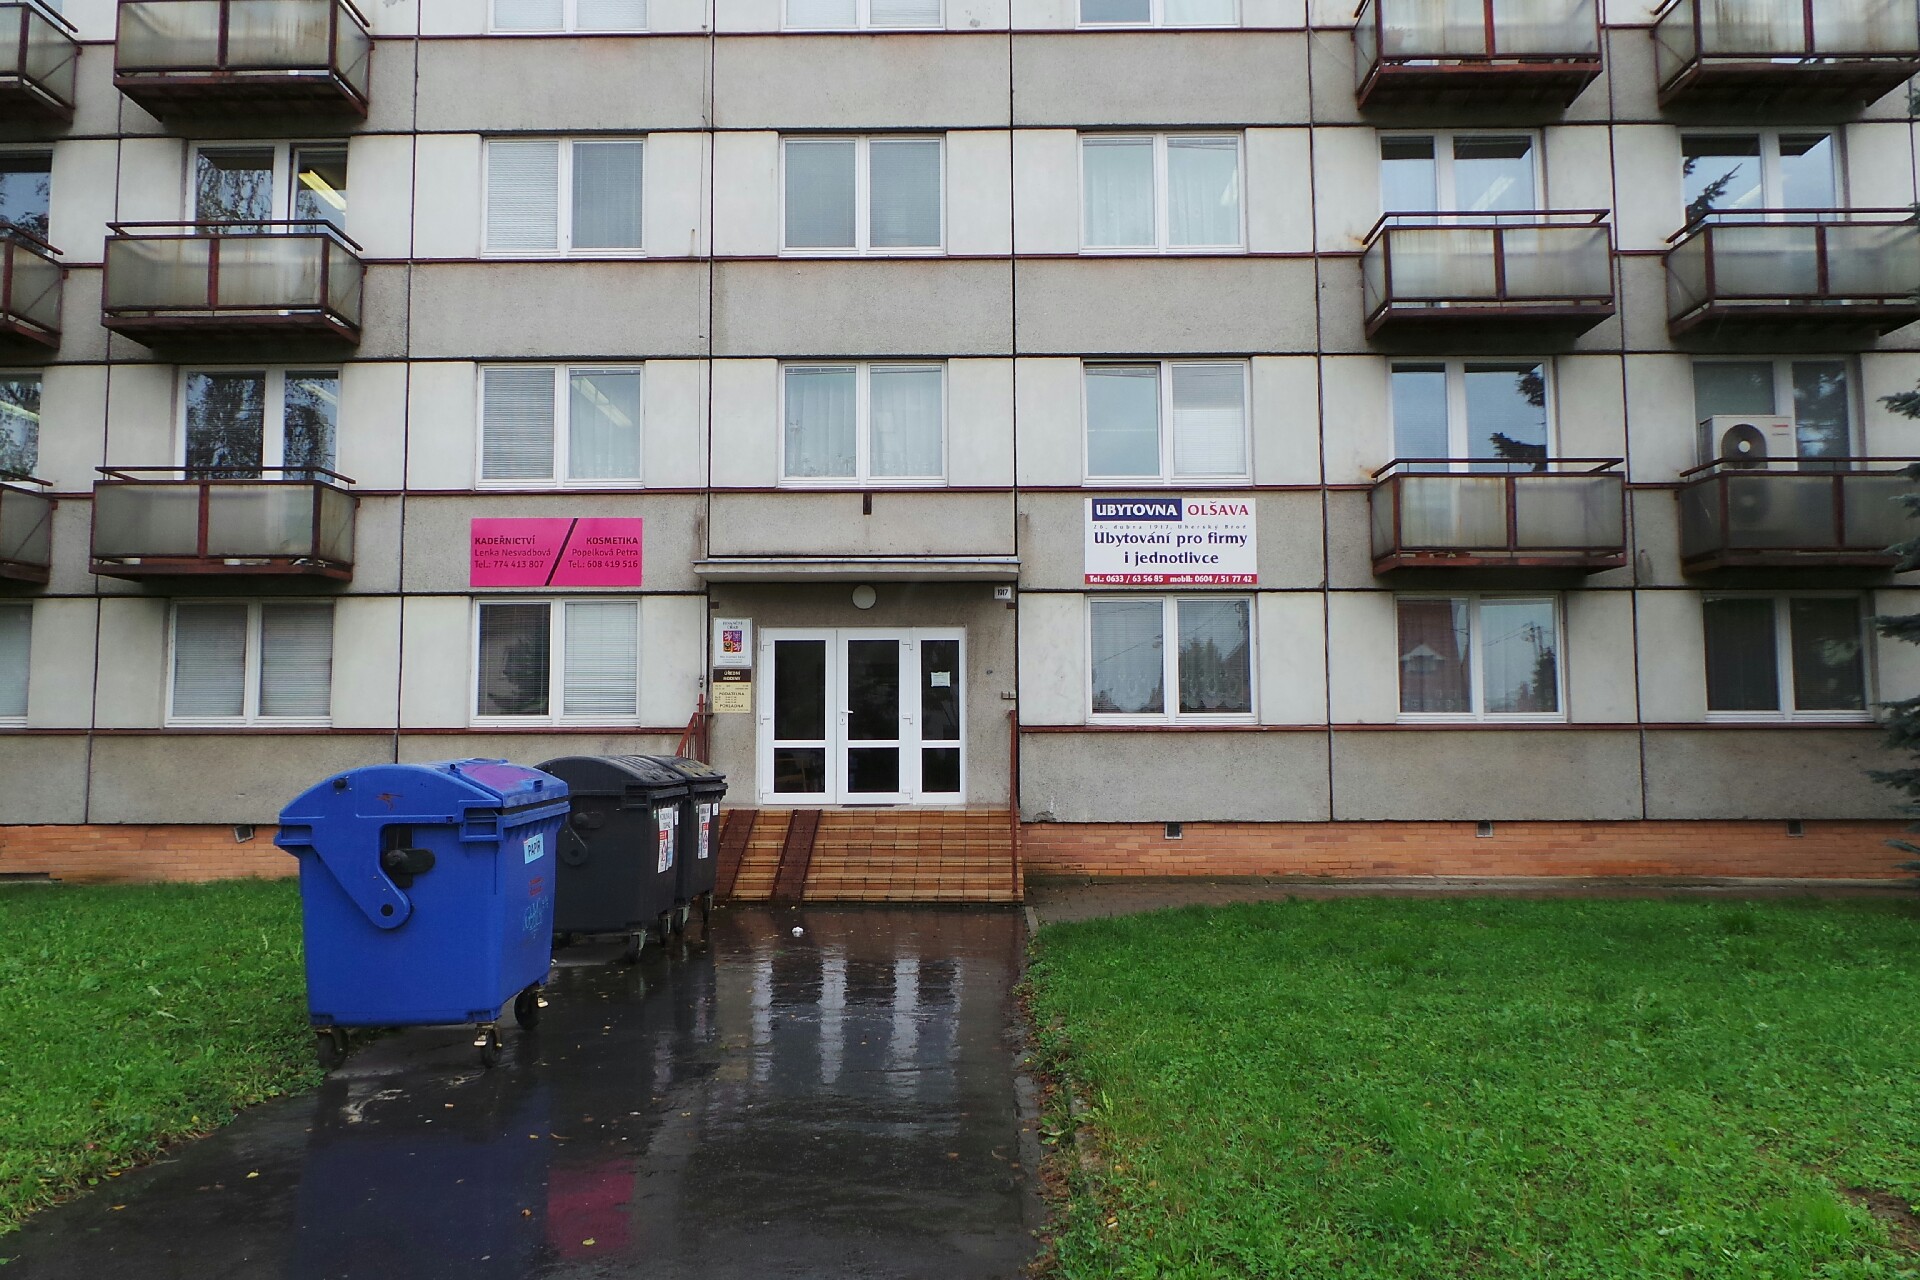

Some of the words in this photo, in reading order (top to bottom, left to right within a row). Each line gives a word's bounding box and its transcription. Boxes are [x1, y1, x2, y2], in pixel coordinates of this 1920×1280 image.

[1096, 504, 1178, 516] UBYTOVNA
[1187, 501, 1249, 516] OLŠAVA
[474, 534, 536, 545] KADEŘNICTVÍ
[586, 536, 639, 545] KOSMETIKA
[1094, 531, 1172, 547] Ubytování
[1176, 535, 1203, 547] pro
[1207, 532, 1248, 547] firmy
[474, 549, 500, 557] Lenka
[502, 549, 551, 557] Nesvadbová
[572, 549, 614, 558] Popelková
[616, 549, 639, 557] Petra
[1124, 551, 1129, 564] i
[1134, 551, 1219, 567] jednotlivce
[474, 560, 491, 568] Tel.:
[493, 560, 509, 568] 774
[511, 560, 527, 568] 413
[528, 560, 544, 568] 807
[568, 560, 585, 568] Tel.:
[587, 560, 602, 568] 608
[604, 560, 620, 568] 419
[622, 560, 638, 568] 516
[1089, 575, 1104, 583] Tel.:
[1106, 575, 1124, 583] 0633
[1132, 575, 1141, 583] 63
[1143, 575, 1153, 583] 56
[1154, 575, 1164, 583] 85
[1194, 575, 1213, 583] 0604
[1220, 575, 1230, 583] 51
[1232, 575, 1241, 583] 77
[1243, 575, 1252, 583] 42
[528, 839, 541, 857] PAPÍR
